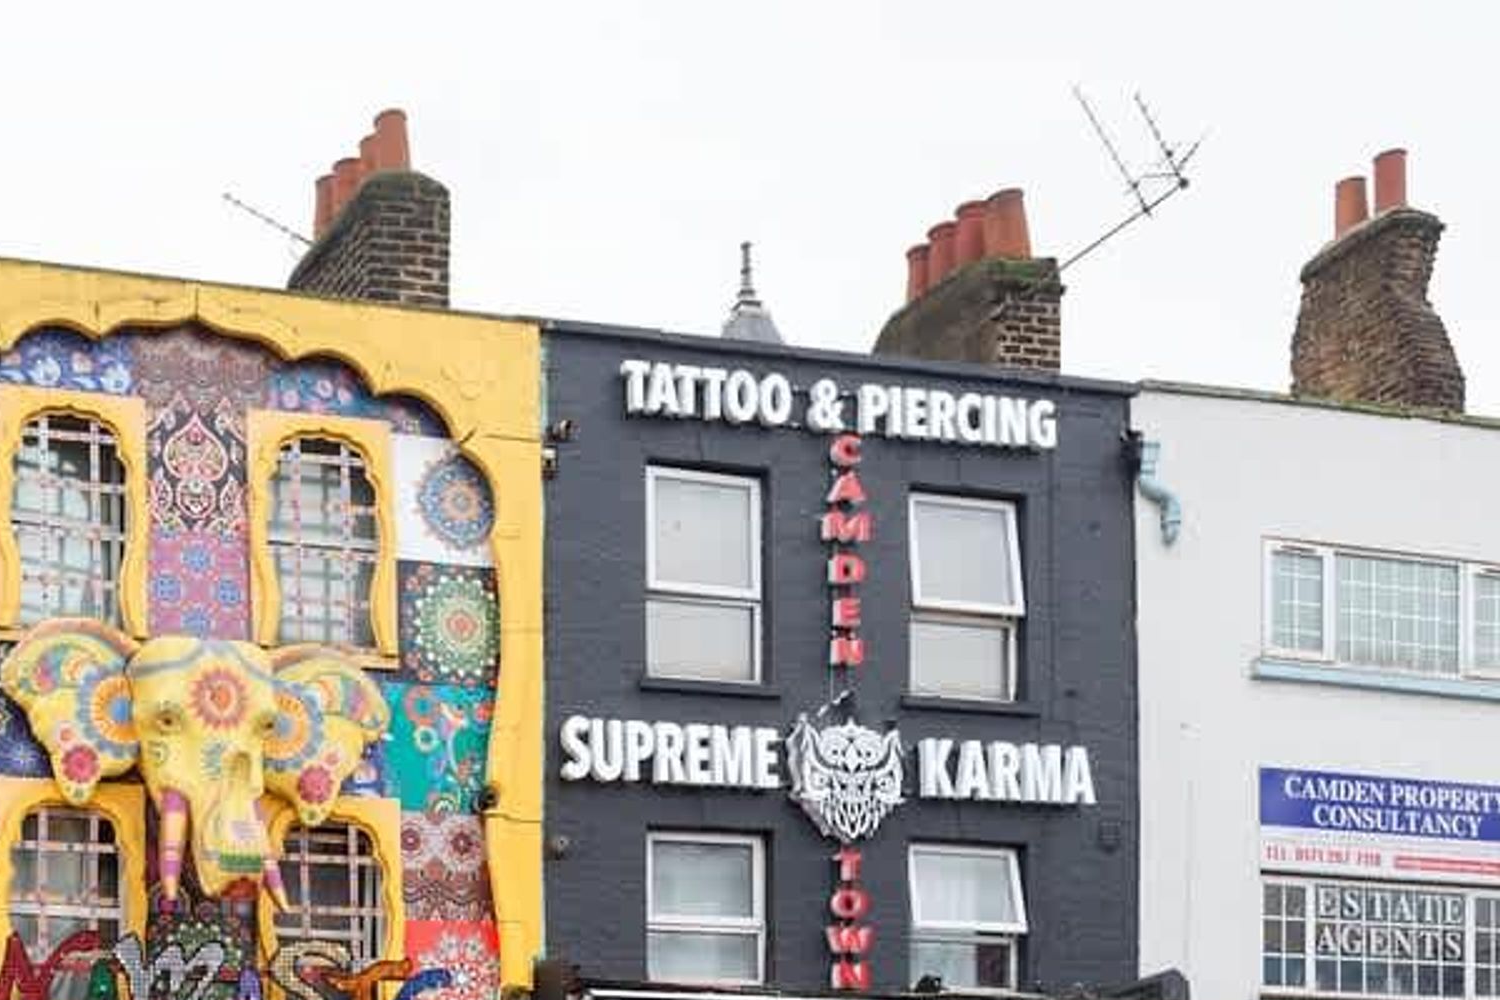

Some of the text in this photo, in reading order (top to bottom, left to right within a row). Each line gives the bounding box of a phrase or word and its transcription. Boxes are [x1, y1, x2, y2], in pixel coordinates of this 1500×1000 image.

[621, 360, 1057, 448] TATTOO & PIERCING
[820, 433, 874, 666] CAMDEN
[560, 715, 1097, 804] SUPREME KARMA
[1284, 776, 1385, 805] CAMDEN
[1313, 803, 1482, 838] CONSULTANCY
[826, 846, 875, 989] TOWN
[1319, 886, 1462, 924] ESTATE
[1317, 924, 1462, 959] AGENTS
